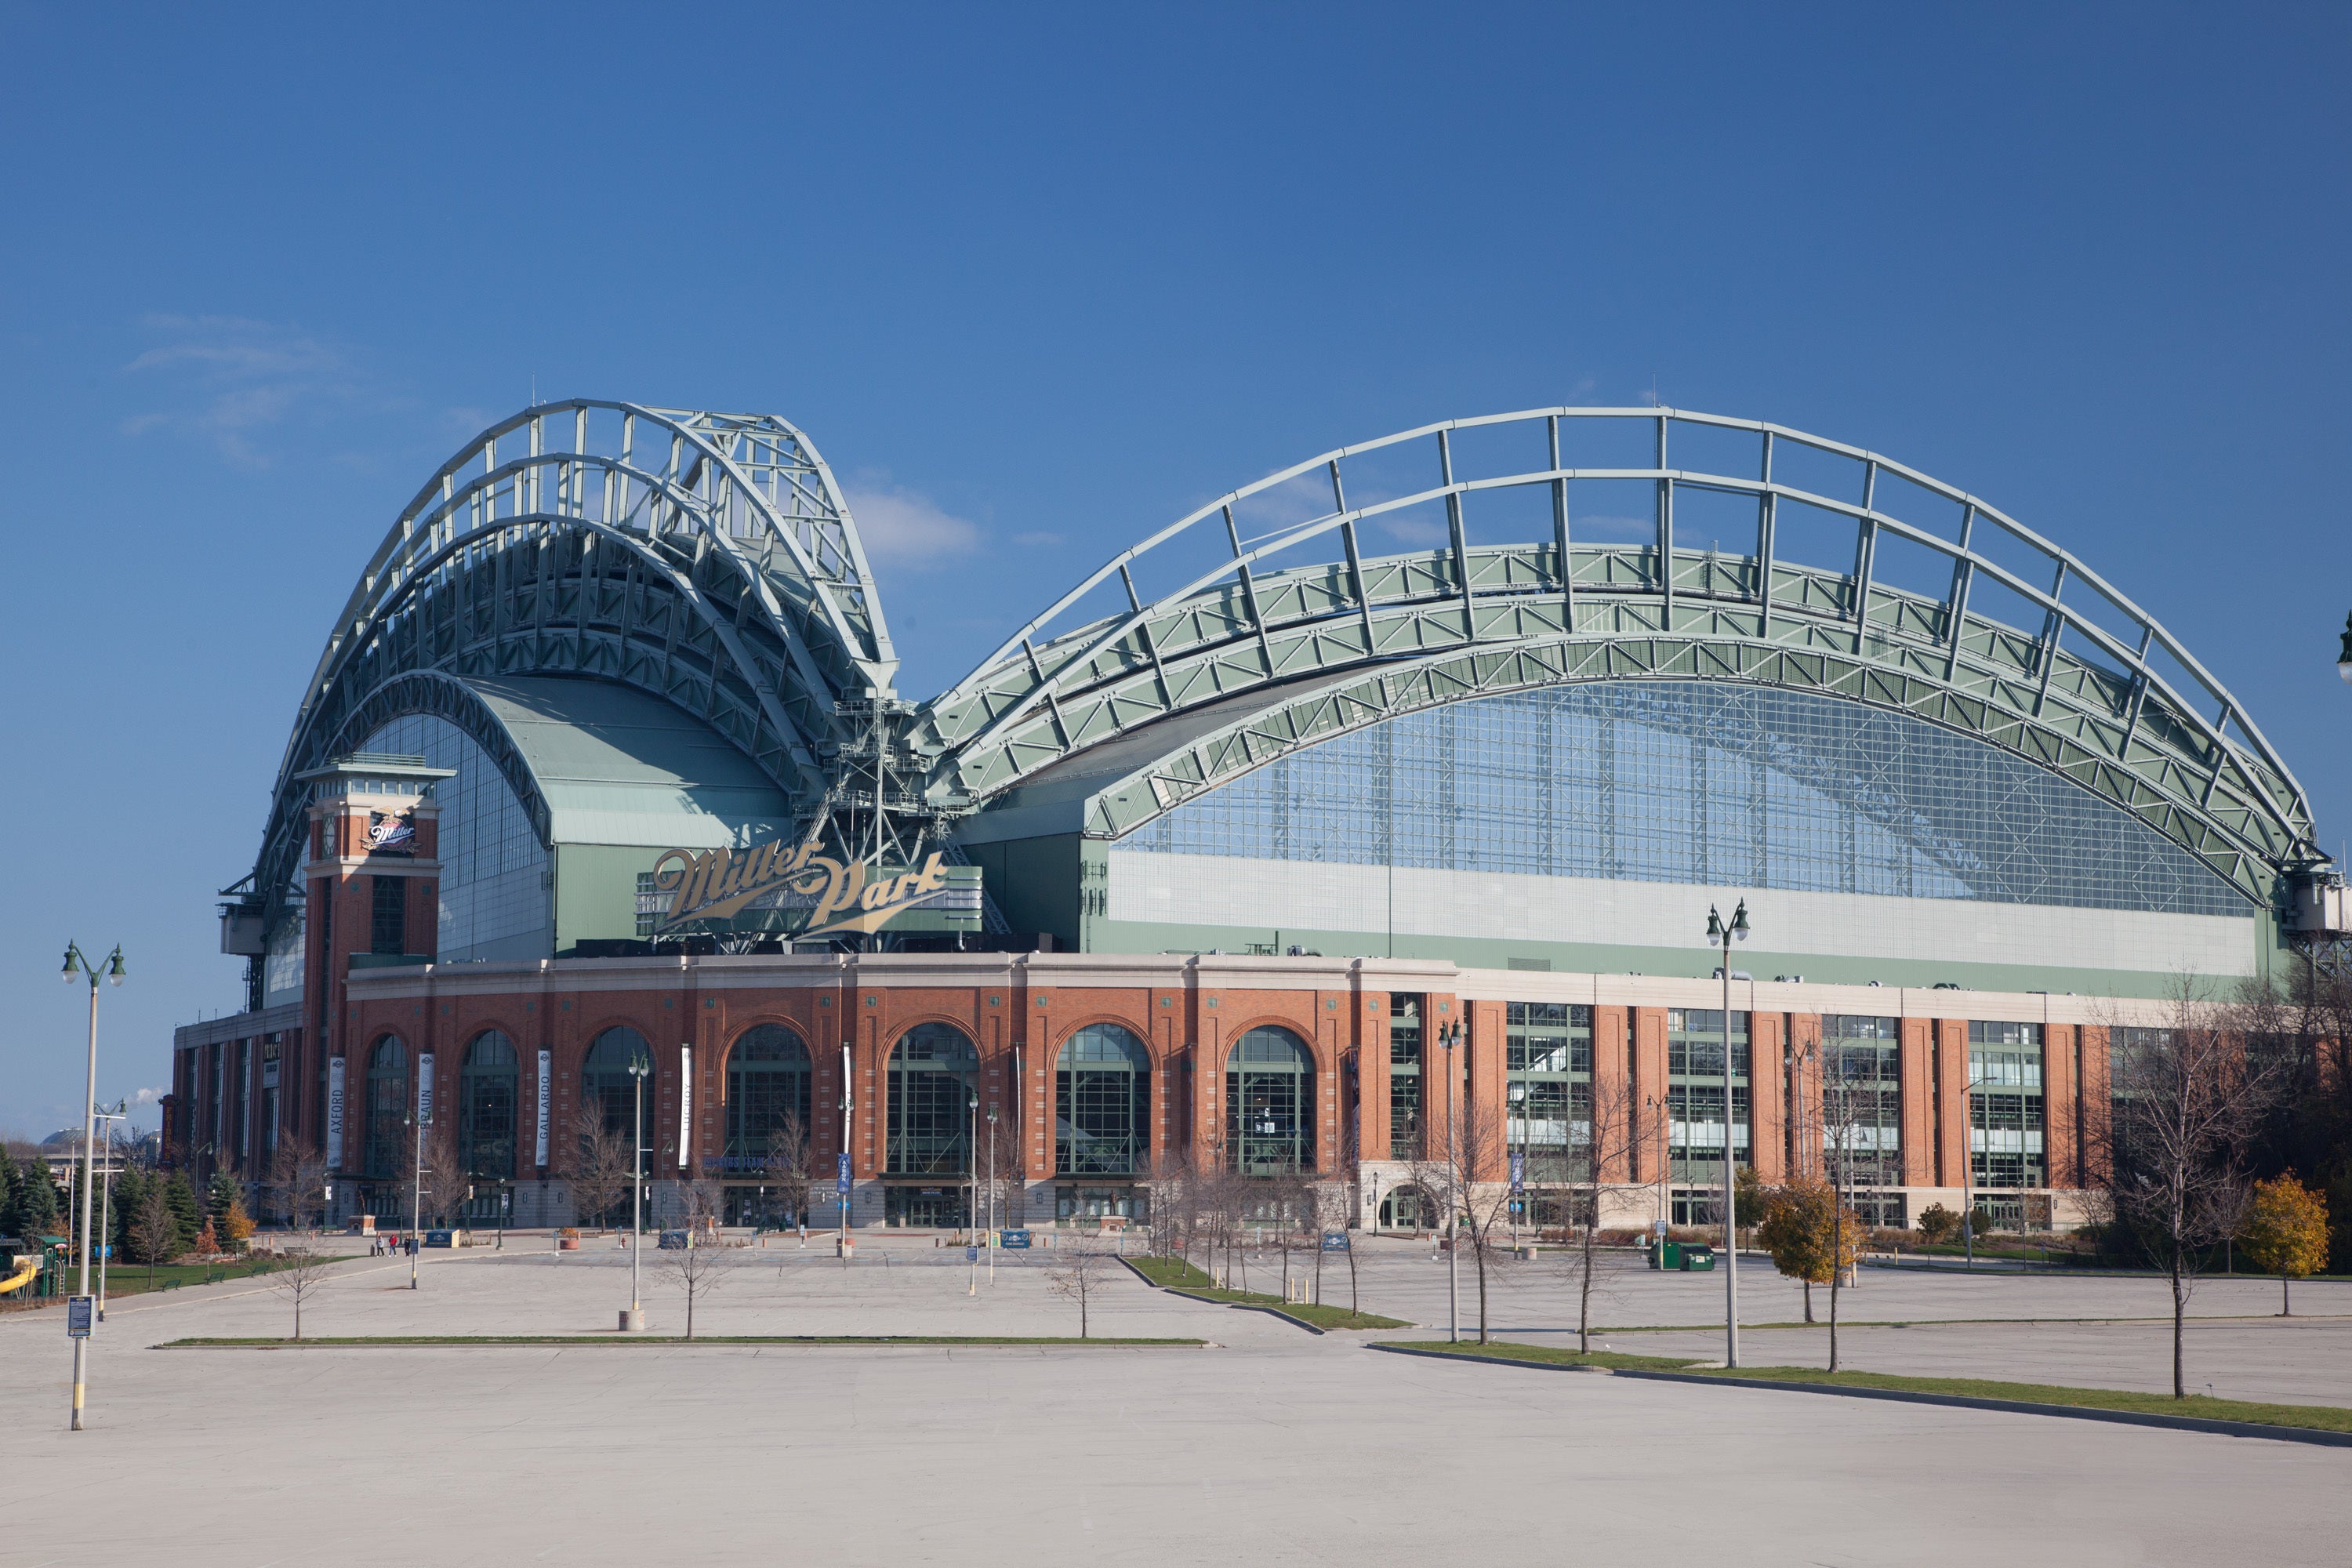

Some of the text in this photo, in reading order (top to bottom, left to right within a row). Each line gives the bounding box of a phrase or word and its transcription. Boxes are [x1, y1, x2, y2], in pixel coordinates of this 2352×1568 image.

[371, 826, 415, 843] Miller
[653, 838, 948, 931] Miller Park
[331, 1090, 343, 1134] AXFORD
[539, 1076, 550, 1139] GALLARDO
